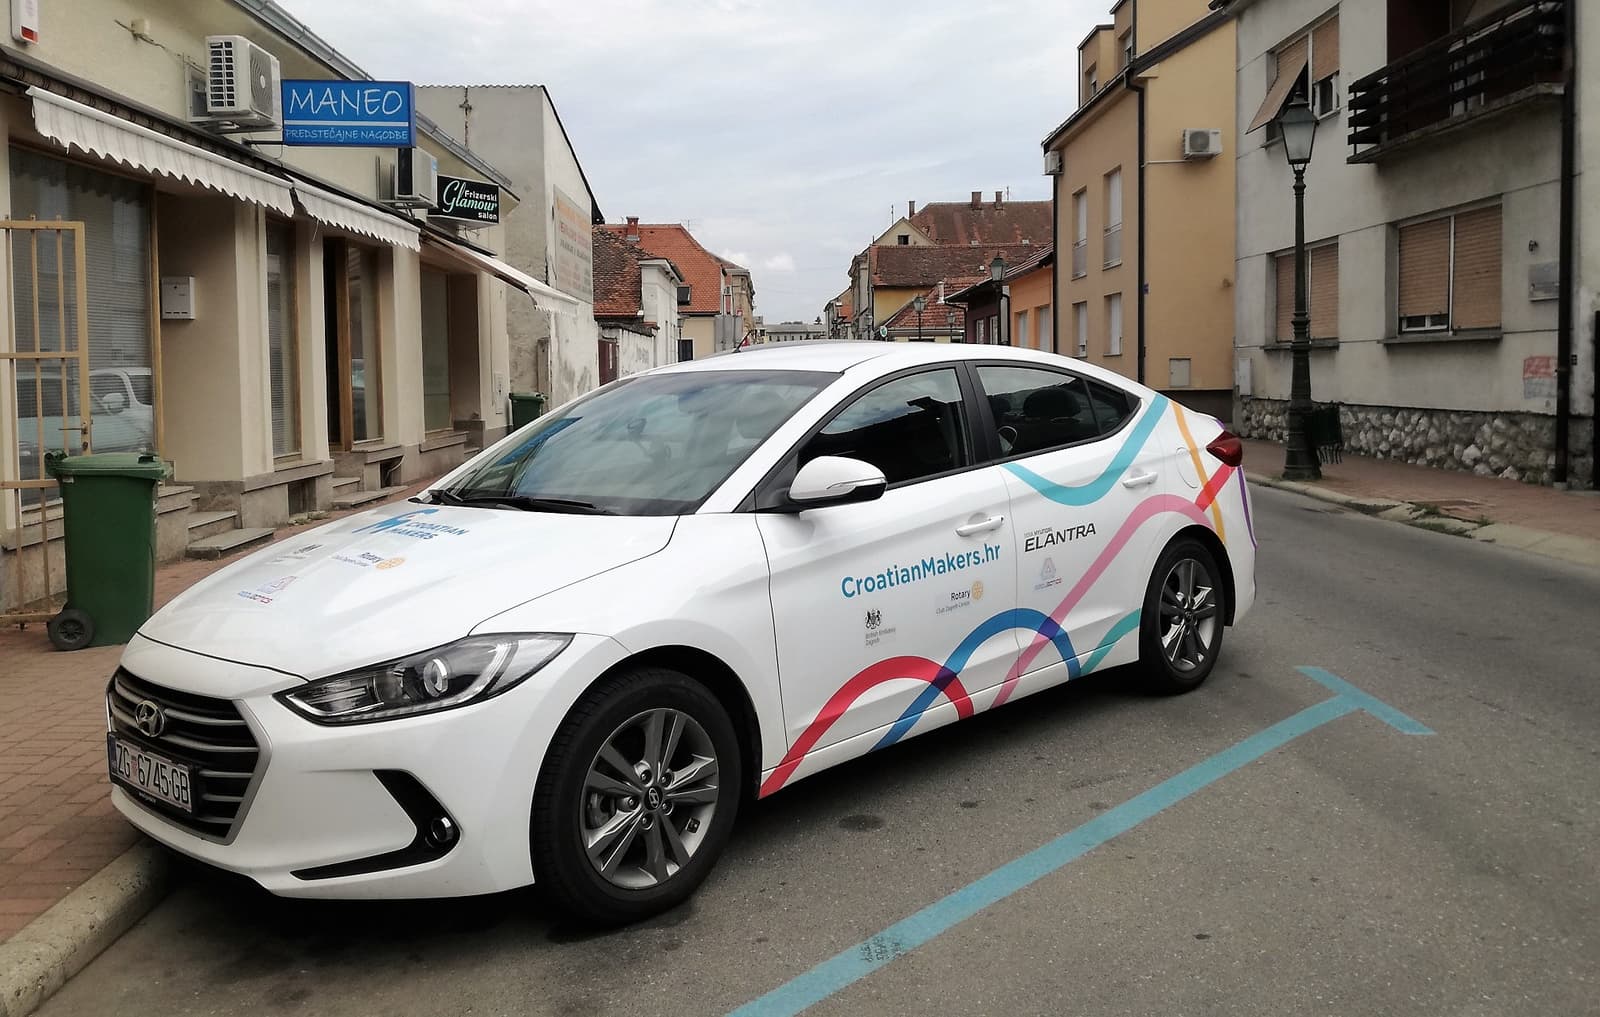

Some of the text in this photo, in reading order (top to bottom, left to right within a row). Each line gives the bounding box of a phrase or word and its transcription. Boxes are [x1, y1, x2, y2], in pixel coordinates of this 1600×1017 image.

[289, 87, 403, 116] MANEO
[286, 127, 409, 142] PREDSTEČAJNE NAGODBE
[442, 180, 498, 213] Glamour
[464, 189, 498, 202] Frizerski
[477, 211, 498, 220] salon
[389, 527, 439, 540] MAKERS
[406, 521, 470, 536] CROATIAN
[1024, 522, 1097, 552] ELANTRA
[841, 542, 1001, 598] CroatianMakers.hr
[950, 588, 971, 601] Rotary
[116, 743, 131, 779] ZG
